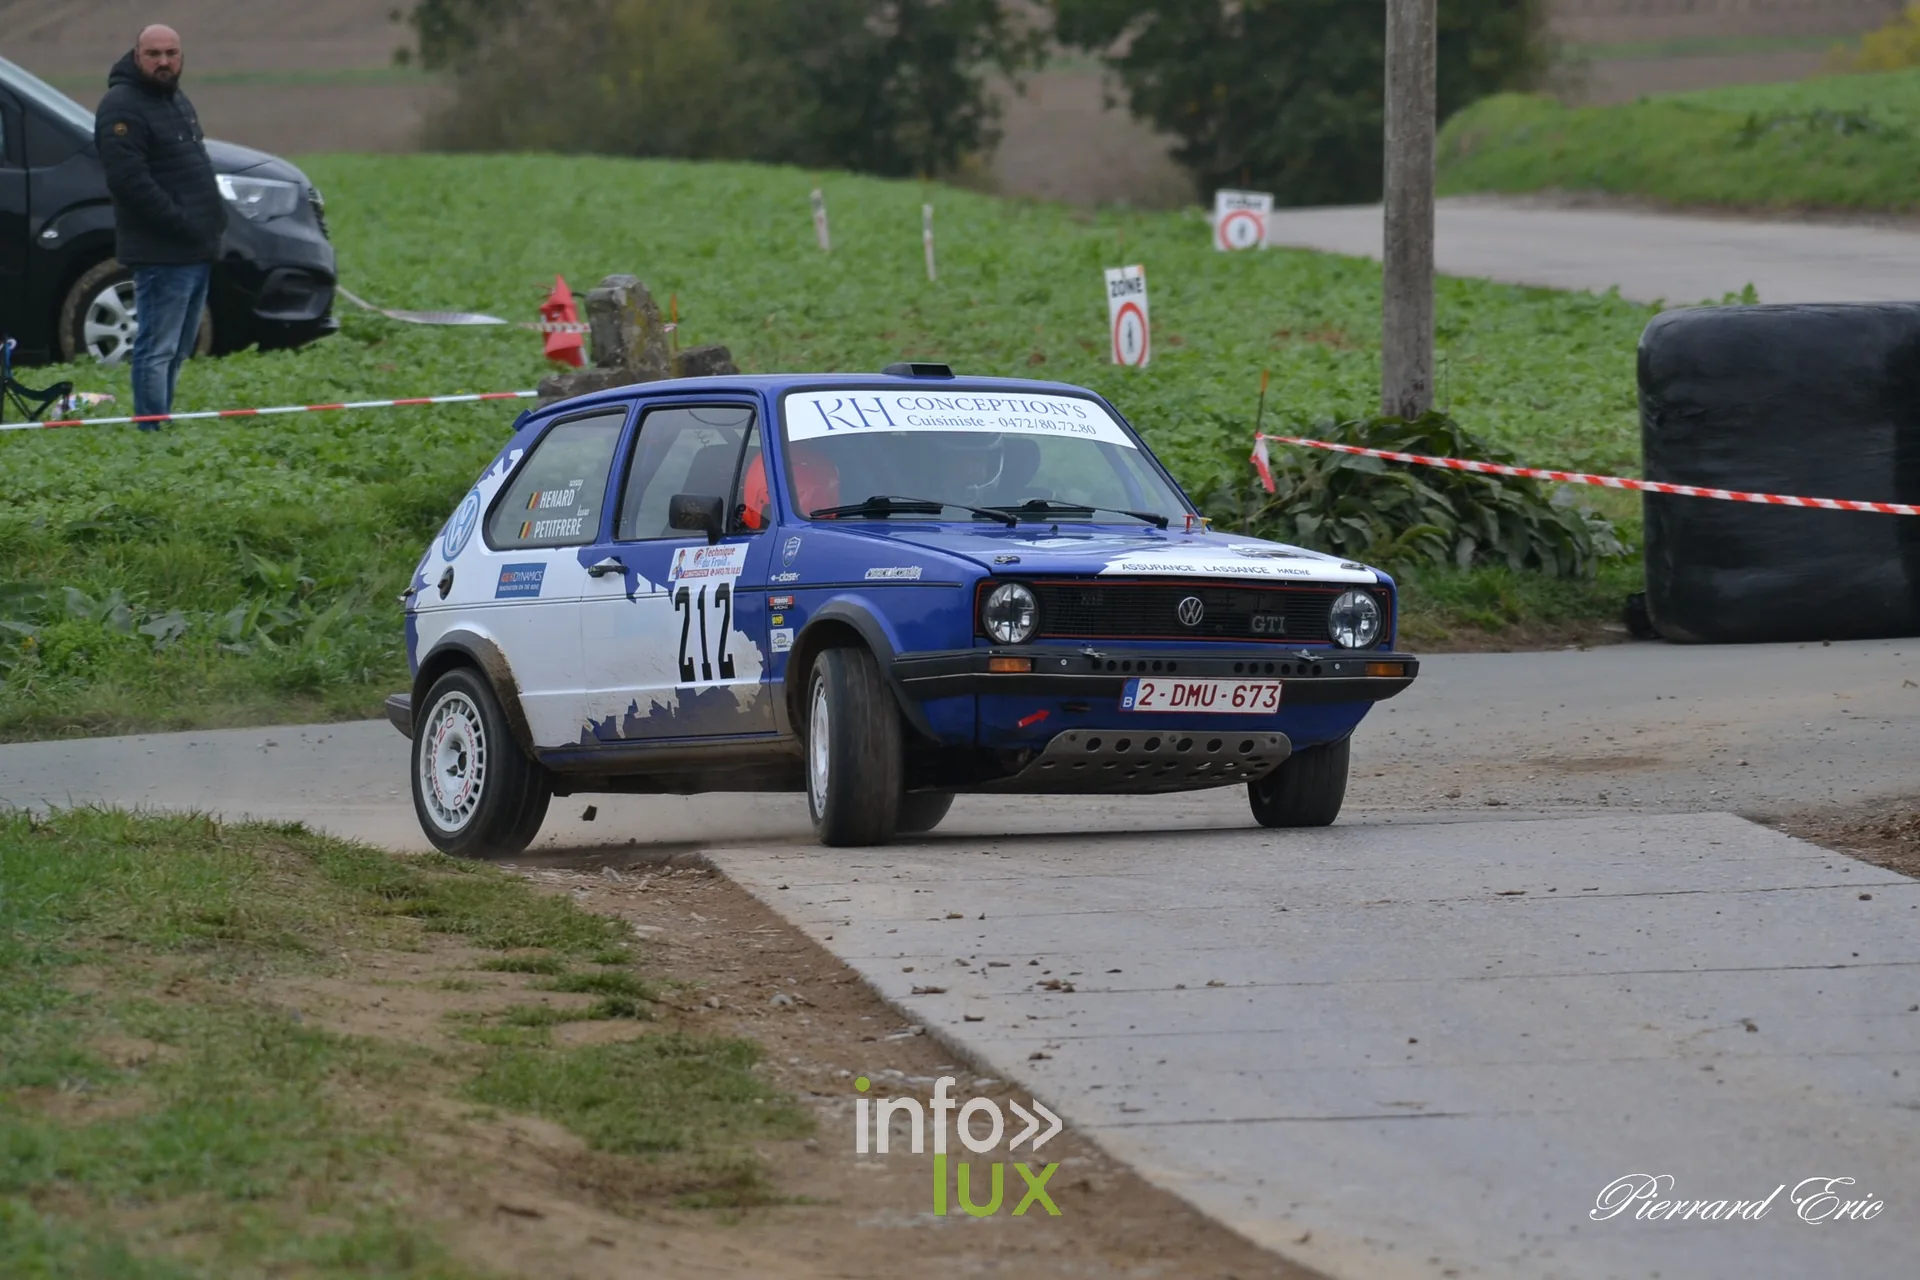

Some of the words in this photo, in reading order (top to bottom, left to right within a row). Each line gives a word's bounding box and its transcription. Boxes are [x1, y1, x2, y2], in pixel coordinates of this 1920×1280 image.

[1110, 277, 1143, 298] ZONE
[895, 396, 1088, 420] CONCEPTION'S
[907, 414, 986, 428] Cuisiniste
[998, 416, 1097, 436] 0472/80.72.80
[540, 489, 576, 509] HENARD
[534, 517, 583, 539] PETITFRERE
[705, 546, 736, 557] Technique
[1121, 563, 1197, 572] ASSURANCE
[1202, 565, 1271, 575] LASSANCE
[675, 582, 736, 682] 212
[1251, 615, 1286, 634] GTI
[1122, 696, 1134, 708] B
